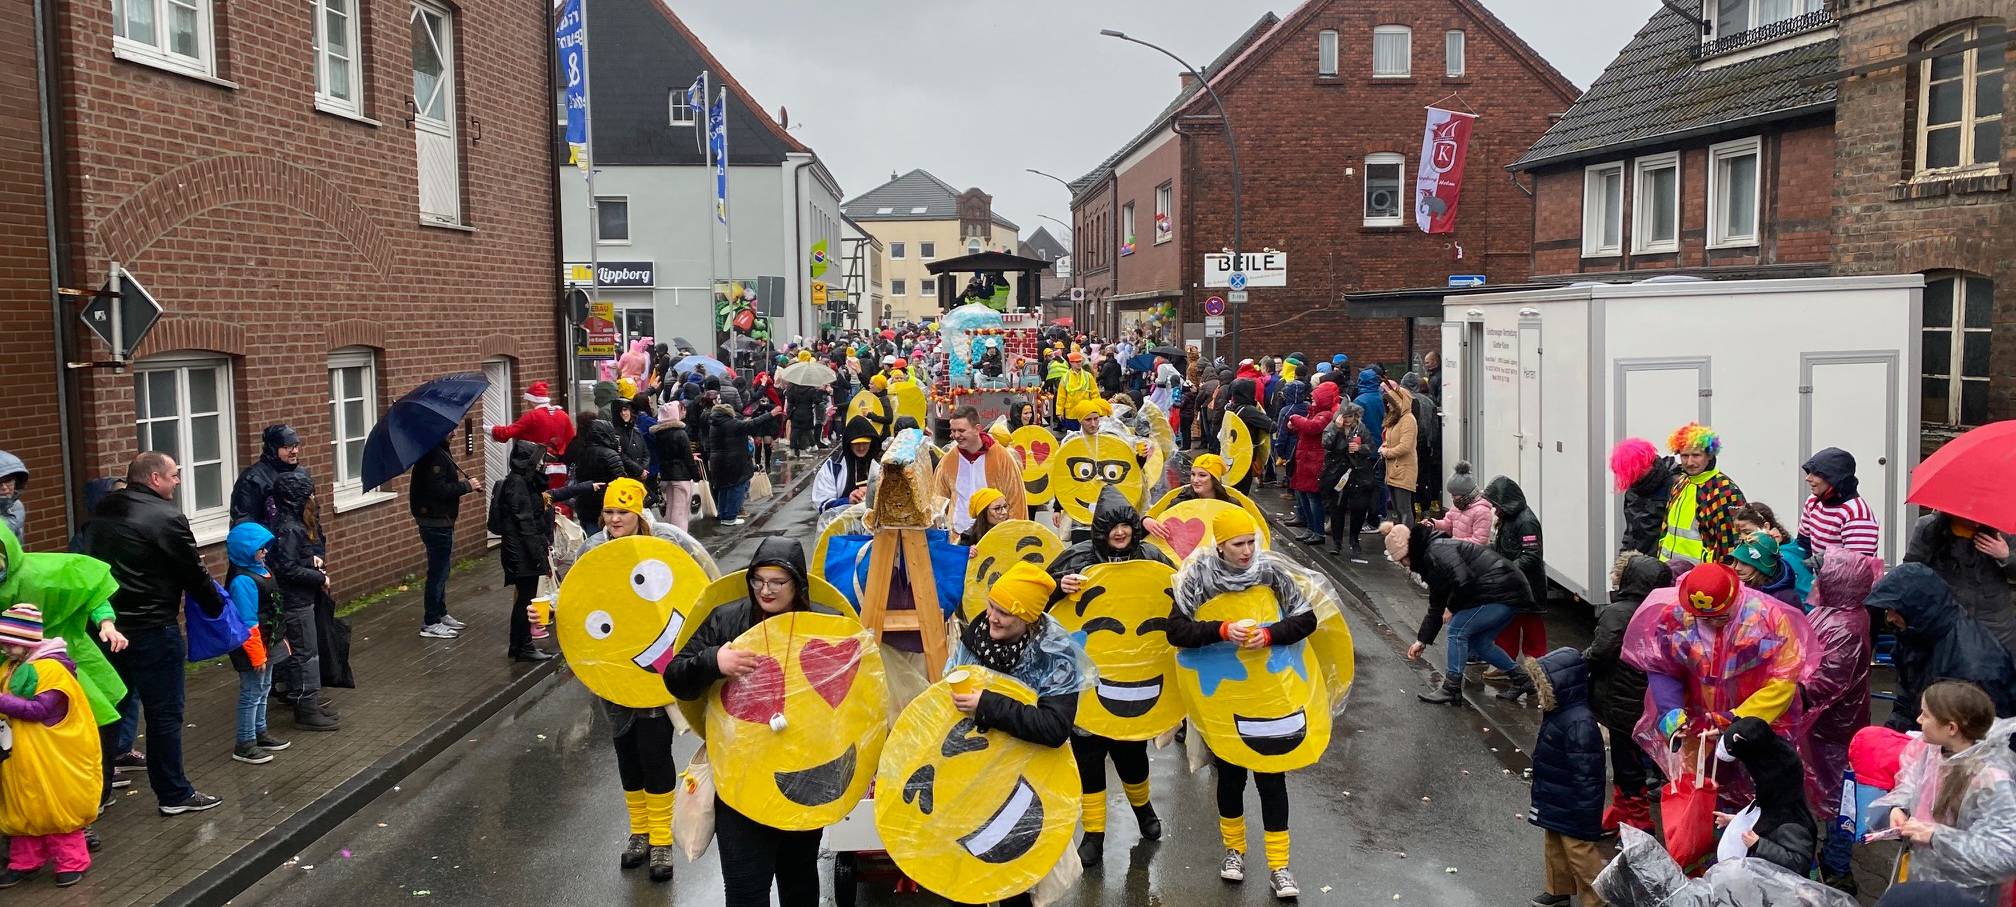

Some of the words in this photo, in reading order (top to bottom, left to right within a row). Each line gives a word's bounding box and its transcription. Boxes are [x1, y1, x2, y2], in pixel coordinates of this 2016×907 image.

[1438, 145, 1450, 162] K
[1206, 255, 1284, 271] BEILE
[598, 267, 650, 283] Lippborg
